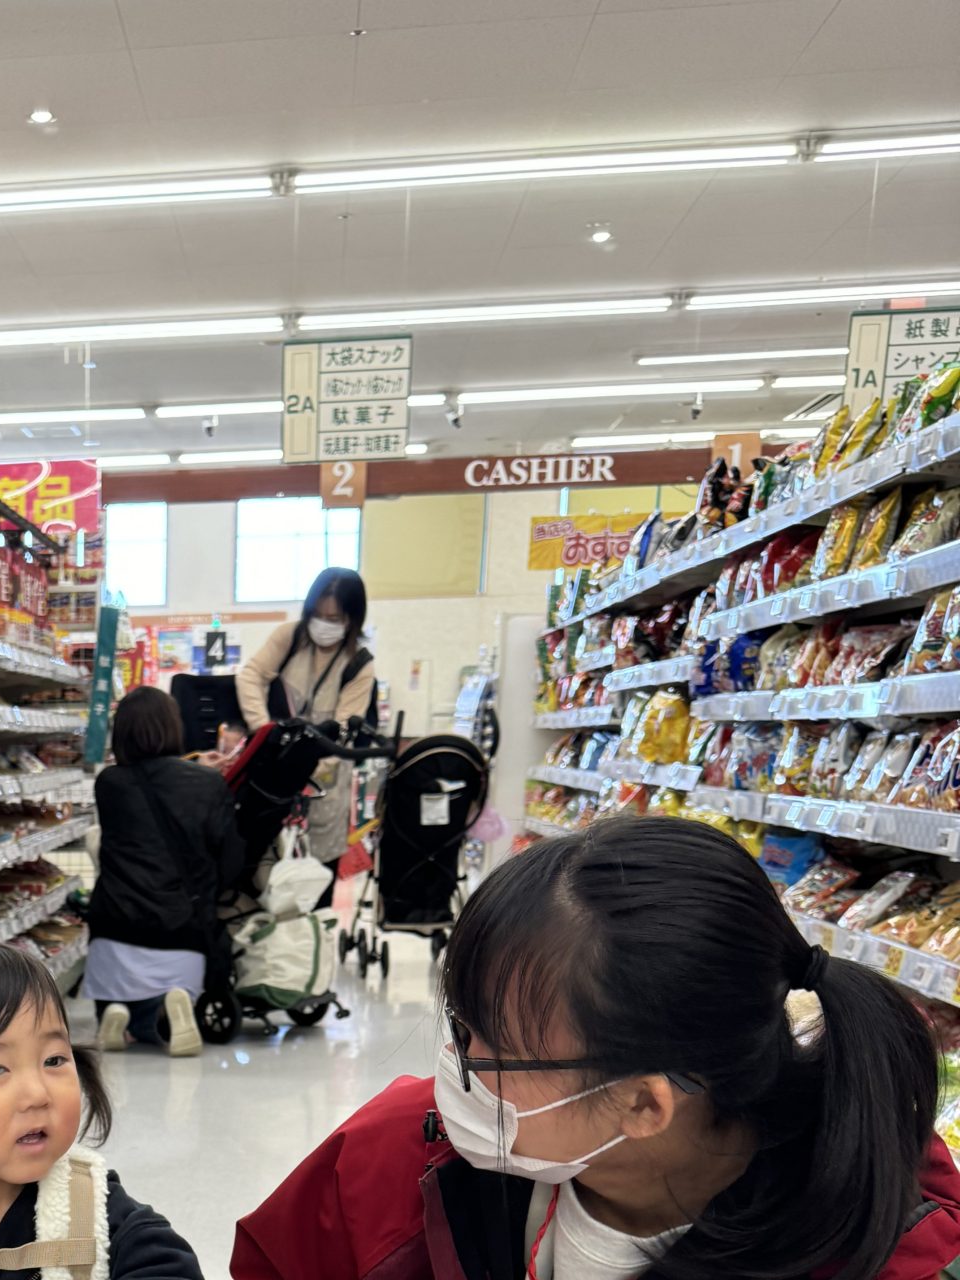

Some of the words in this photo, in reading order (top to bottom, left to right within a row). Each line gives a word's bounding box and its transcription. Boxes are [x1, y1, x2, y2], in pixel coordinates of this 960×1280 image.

[905, 317, 960, 339] 紙製
[326, 346, 404, 368] 大袋スナック
[852, 368, 877, 388] 1A
[286, 394, 315, 415] 2A
[331, 461, 355, 497] 2
[464, 455, 616, 487] CASHIER
[208, 636, 225, 661] 4
